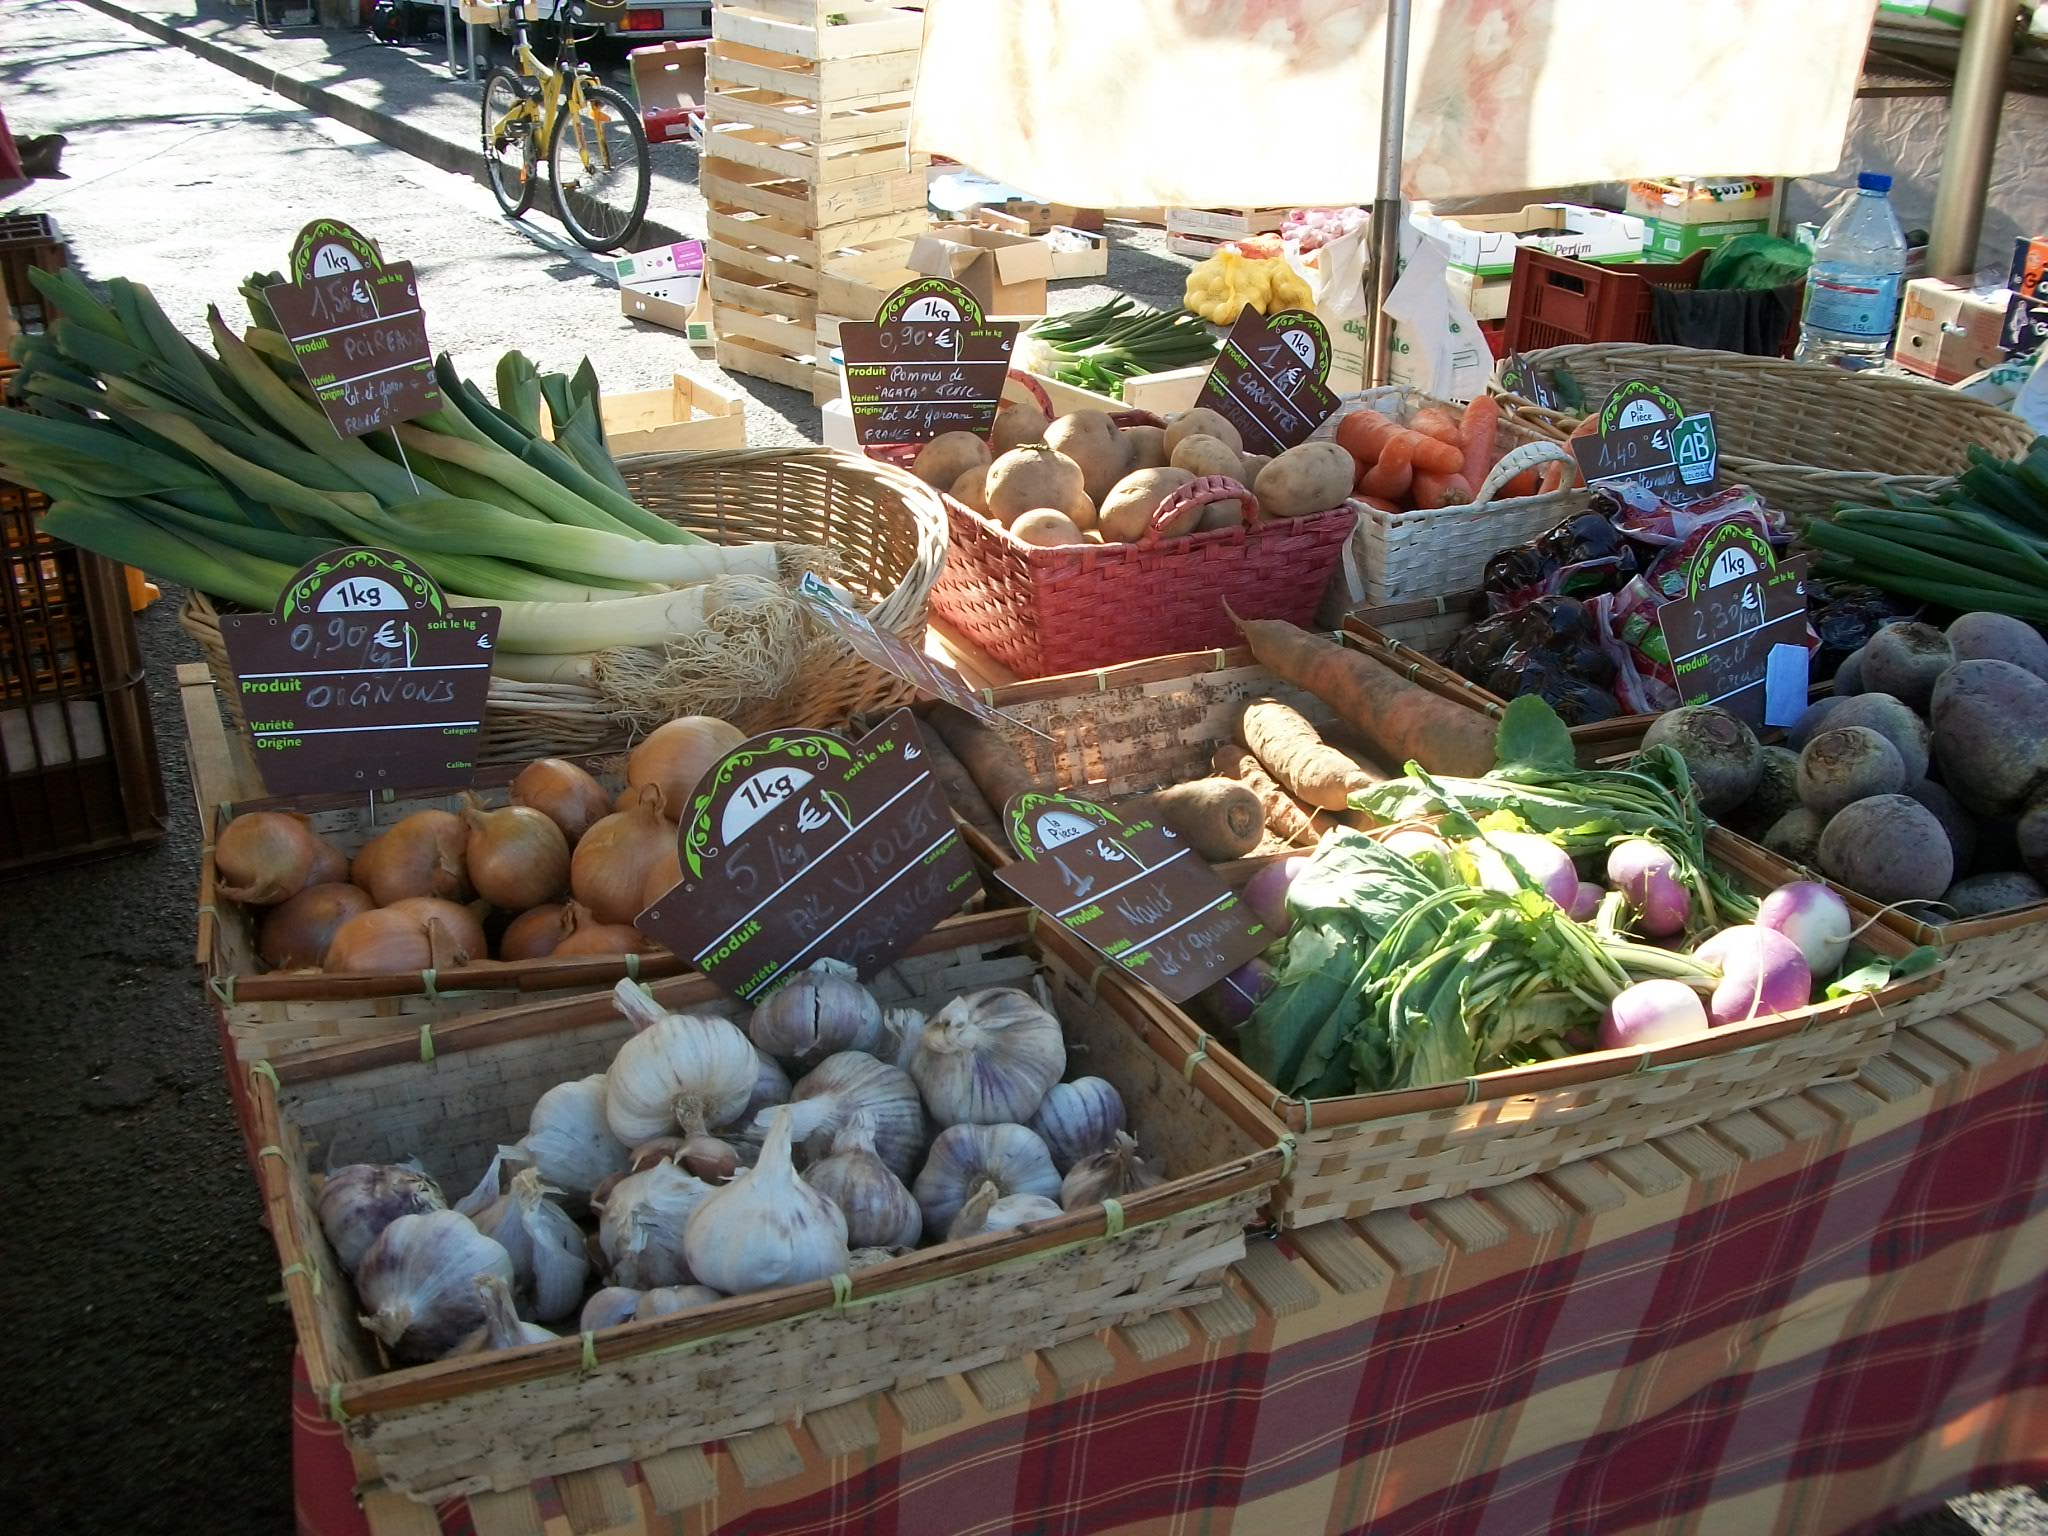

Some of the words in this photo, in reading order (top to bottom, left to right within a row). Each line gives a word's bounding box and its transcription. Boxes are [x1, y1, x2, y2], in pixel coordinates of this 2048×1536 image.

[1554, 242, 1592, 257] Perlim
[322, 248, 350, 272] 1kg
[352, 280, 370, 304] €
[924, 302, 950, 322] 1kg
[296, 339, 328, 354] Produit
[880, 326, 926, 354] 0,90
[934, 328, 954, 348] €
[994, 330, 1002, 338] kg
[1000, 340, 1010, 350] €
[1290, 333, 1310, 357] 1kg
[1226, 344, 1250, 370] Produit
[312, 373, 336, 386] Variété
[848, 366, 886, 376] Produit
[890, 366, 942, 382] Pommes
[950, 367, 965, 381] de
[320, 389, 344, 402] Origine
[852, 394, 880, 402] Variété
[1208, 378, 1226, 398] Origine
[854, 407, 882, 416] Origine
[1635, 400, 1644, 412] la
[1631, 411, 1653, 422] Pièce
[1598, 441, 1637, 470] 1,40
[1650, 429, 1669, 450] €
[1680, 433, 1710, 464] AB
[1720, 551, 1745, 576] 1kg
[336, 582, 382, 607] 1kg
[1740, 582, 1759, 610] €
[1796, 580, 1806, 595] €
[290, 617, 364, 660] 0,90
[373, 620, 402, 648] €
[428, 620, 448, 630] soit
[450, 620, 461, 629] le
[464, 619, 476, 631] kg
[476, 634, 492, 648] €
[1676, 654, 1710, 676] Produit
[242, 678, 302, 694] Produit
[250, 719, 294, 732] Variété
[256, 738, 302, 751] Origine
[442, 726, 478, 736] Catégorie
[903, 742, 921, 760] €
[446, 761, 472, 770] Calibre
[740, 774, 795, 810] 1kg
[796, 796, 831, 834] €
[842, 760, 865, 782] soit
[864, 752, 878, 765] le
[876, 738, 895, 756] kg
[1048, 826, 1080, 842] Pièce
[1162, 826, 1177, 838] €
[1096, 838, 1125, 862] €
[946, 870, 972, 892] Calibre
[734, 960, 780, 998] Variété
[924, 834, 959, 866] Catégorie
[1064, 904, 1104, 928] Produit
[700, 918, 762, 972] Produit
